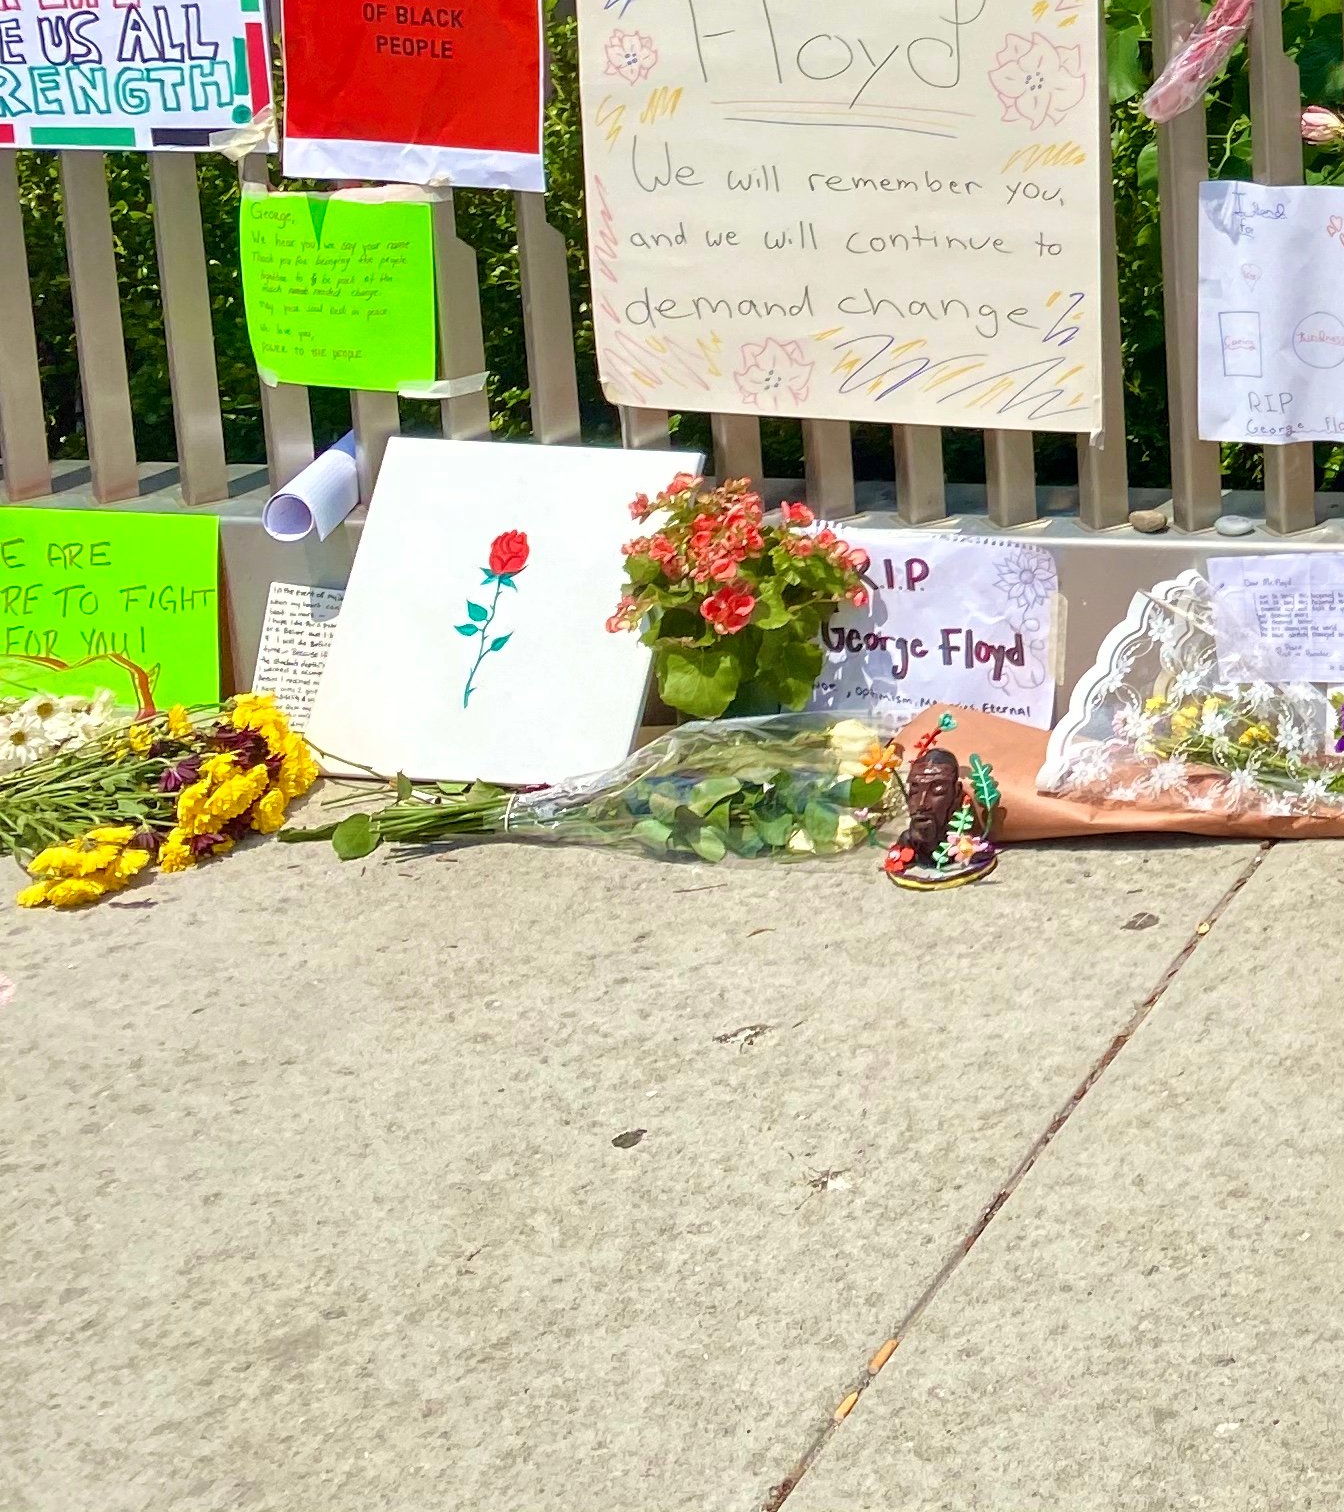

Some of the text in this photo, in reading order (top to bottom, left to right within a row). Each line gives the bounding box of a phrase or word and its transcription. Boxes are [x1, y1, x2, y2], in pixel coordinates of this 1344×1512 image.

[362, 2, 464, 28] OF BLACK
[40, 3, 218, 67] US ALL
[376, 35, 453, 59] PEOPLE
[632, 135, 981, 196] We will remember
[631, 222, 1062, 256] and we will continue to
[625, 286, 1046, 339] demand change
[1248, 392, 1293, 414] RIP
[47, 543, 111, 569] ARE
[53, 585, 216, 617] TO FIGHT
[7, 626, 57, 656] FOR
[821, 602, 1025, 681] George Floyd
